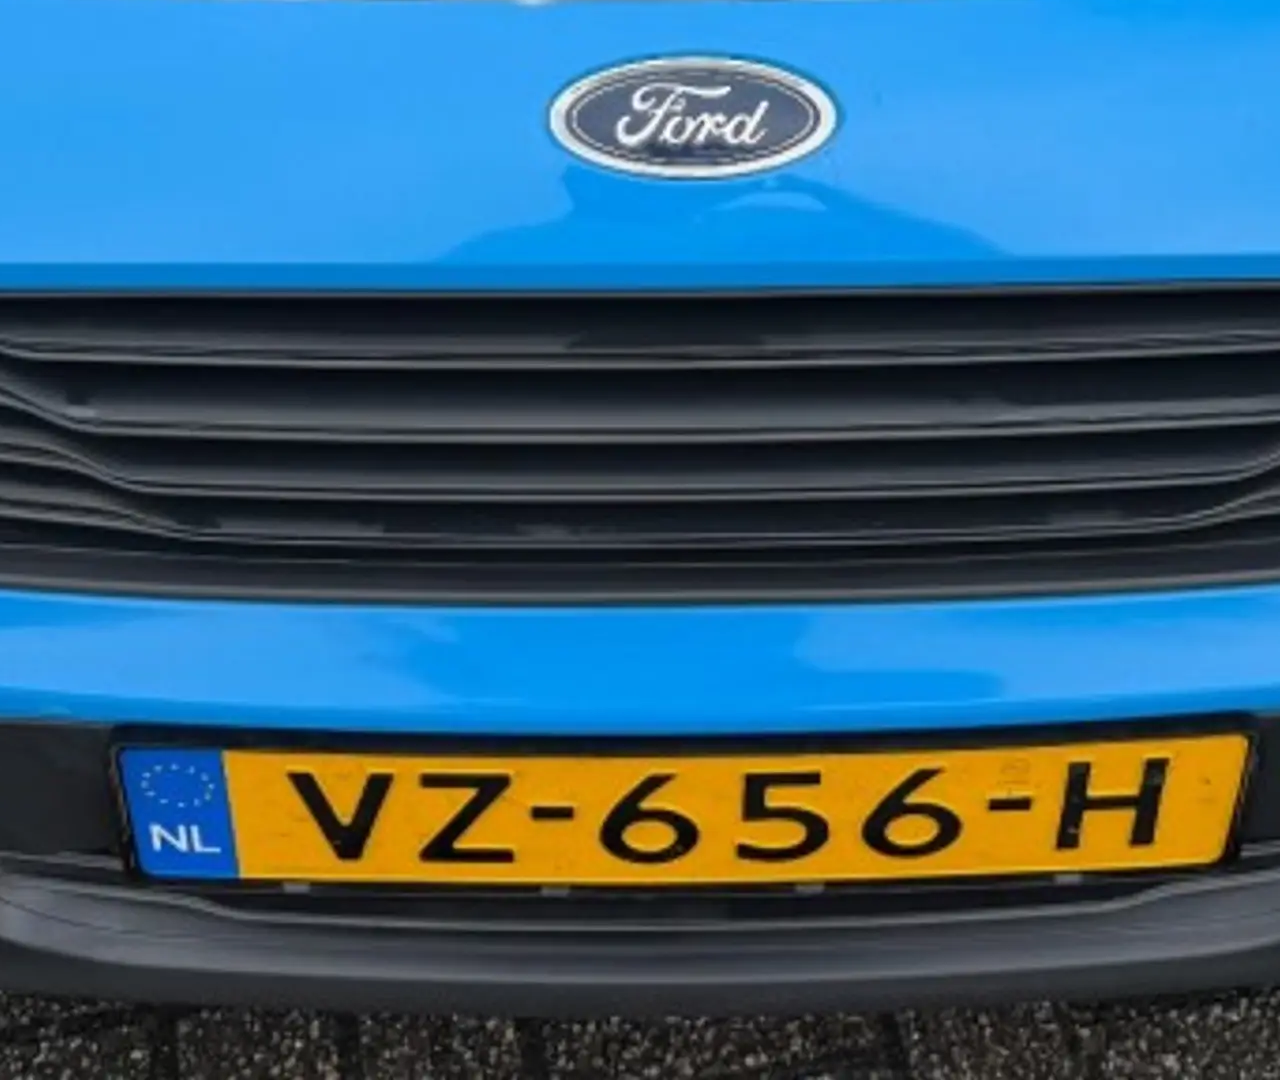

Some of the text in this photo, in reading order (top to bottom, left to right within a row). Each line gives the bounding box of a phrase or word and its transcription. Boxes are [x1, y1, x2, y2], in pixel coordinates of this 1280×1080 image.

[616, 83, 769, 145] Ford
[150, 823, 222, 855] NL
[287, 758, 1170, 865] VZ-656-H
